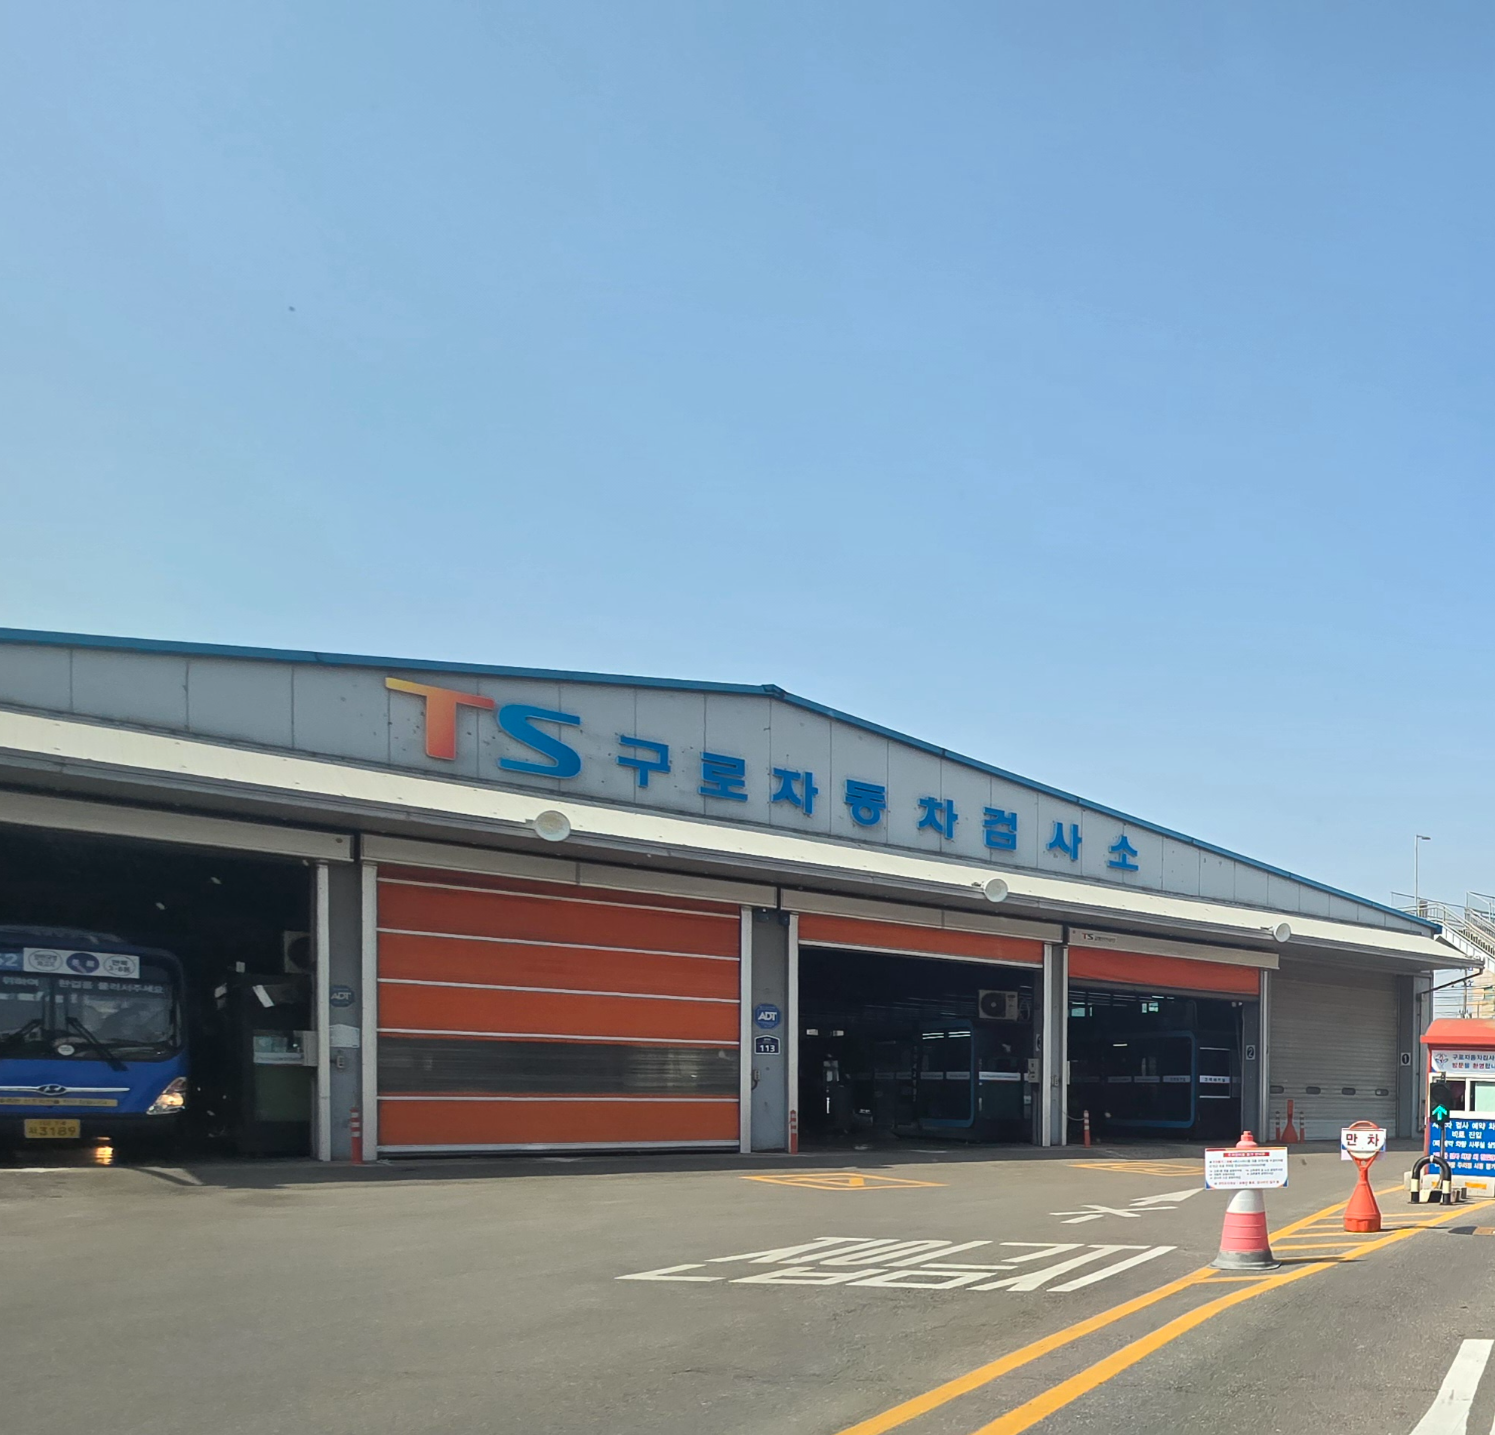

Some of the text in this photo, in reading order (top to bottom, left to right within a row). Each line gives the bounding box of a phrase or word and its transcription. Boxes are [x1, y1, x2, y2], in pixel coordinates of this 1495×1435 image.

[385, 677, 1140, 872] TS 구로자동차검사소
[330, 991, 352, 1000] ADT
[757, 1011, 778, 1021] ADT
[759, 1044, 776, 1053] 113
[614, 1236, 1178, 1292] 진입금지
